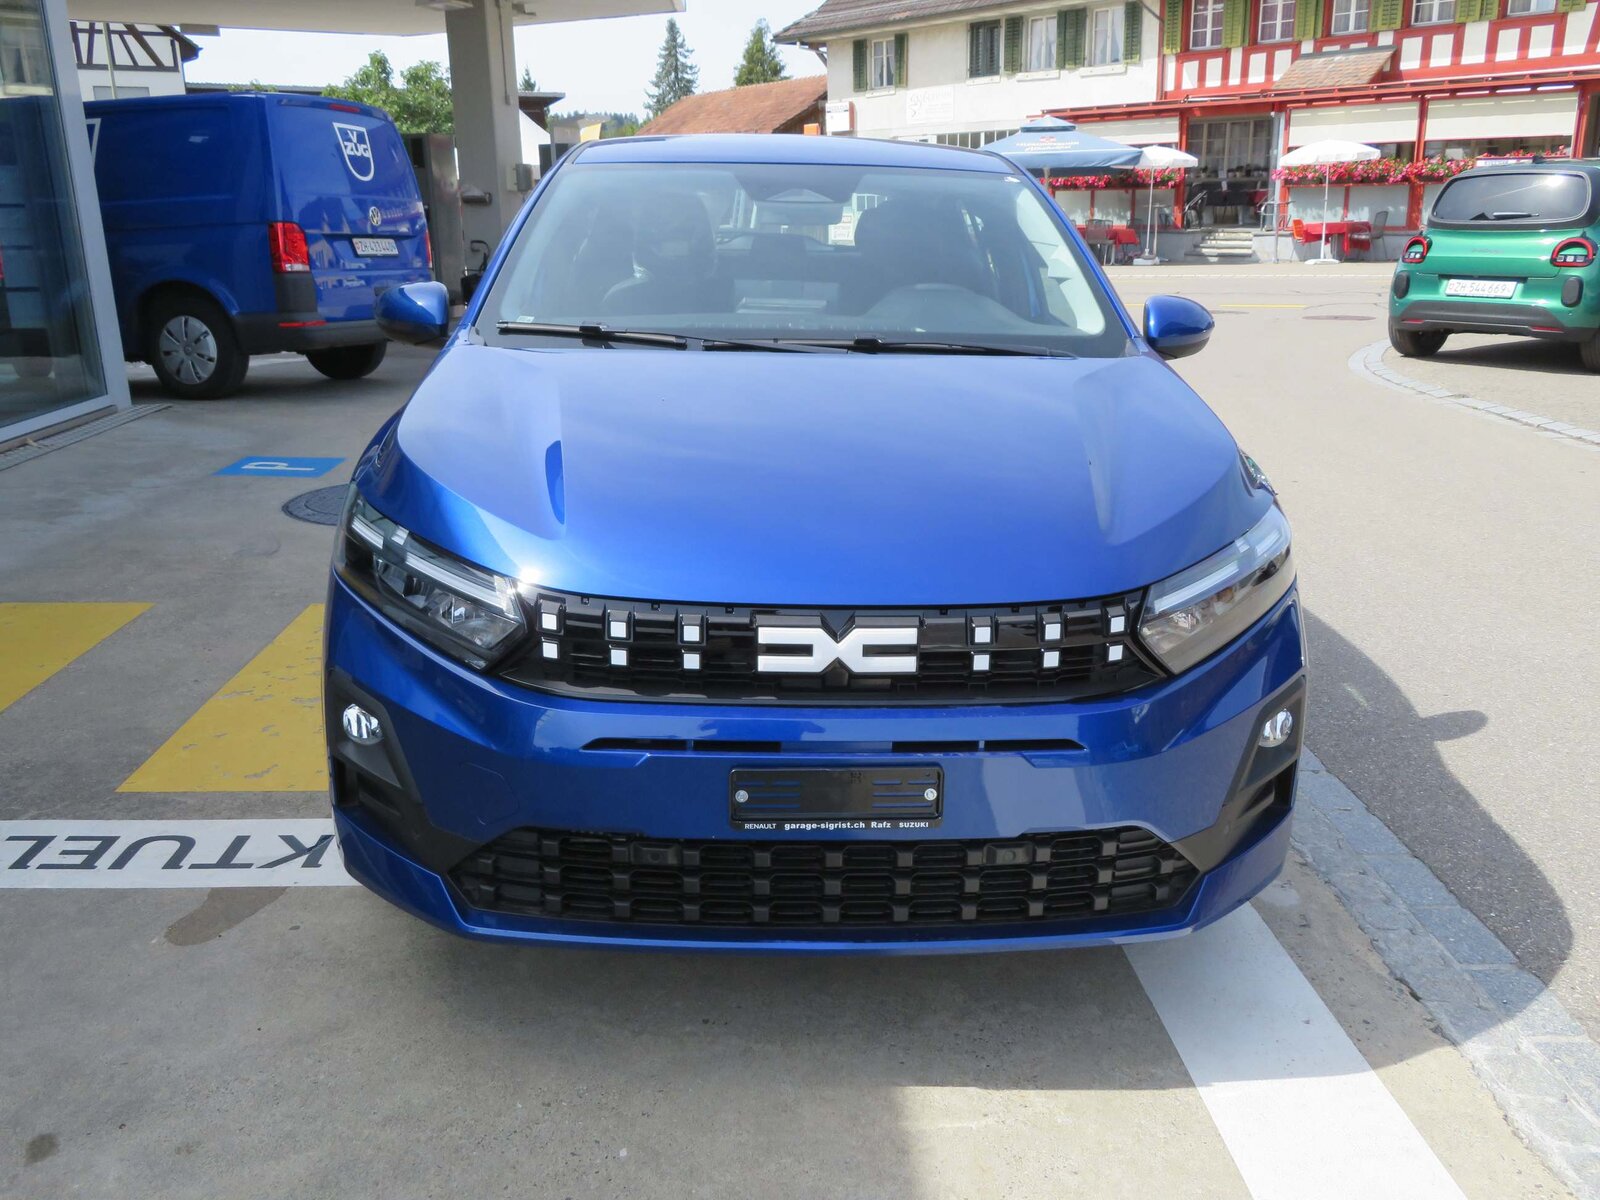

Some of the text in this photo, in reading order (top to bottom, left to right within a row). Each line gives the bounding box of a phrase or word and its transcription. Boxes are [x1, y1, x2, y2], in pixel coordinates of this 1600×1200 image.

[347, 130, 358, 143] V
[344, 142, 370, 158] ZUG
[784, 821, 866, 831] garage-sigrist.ch
[871, 821, 891, 829] Rafz
